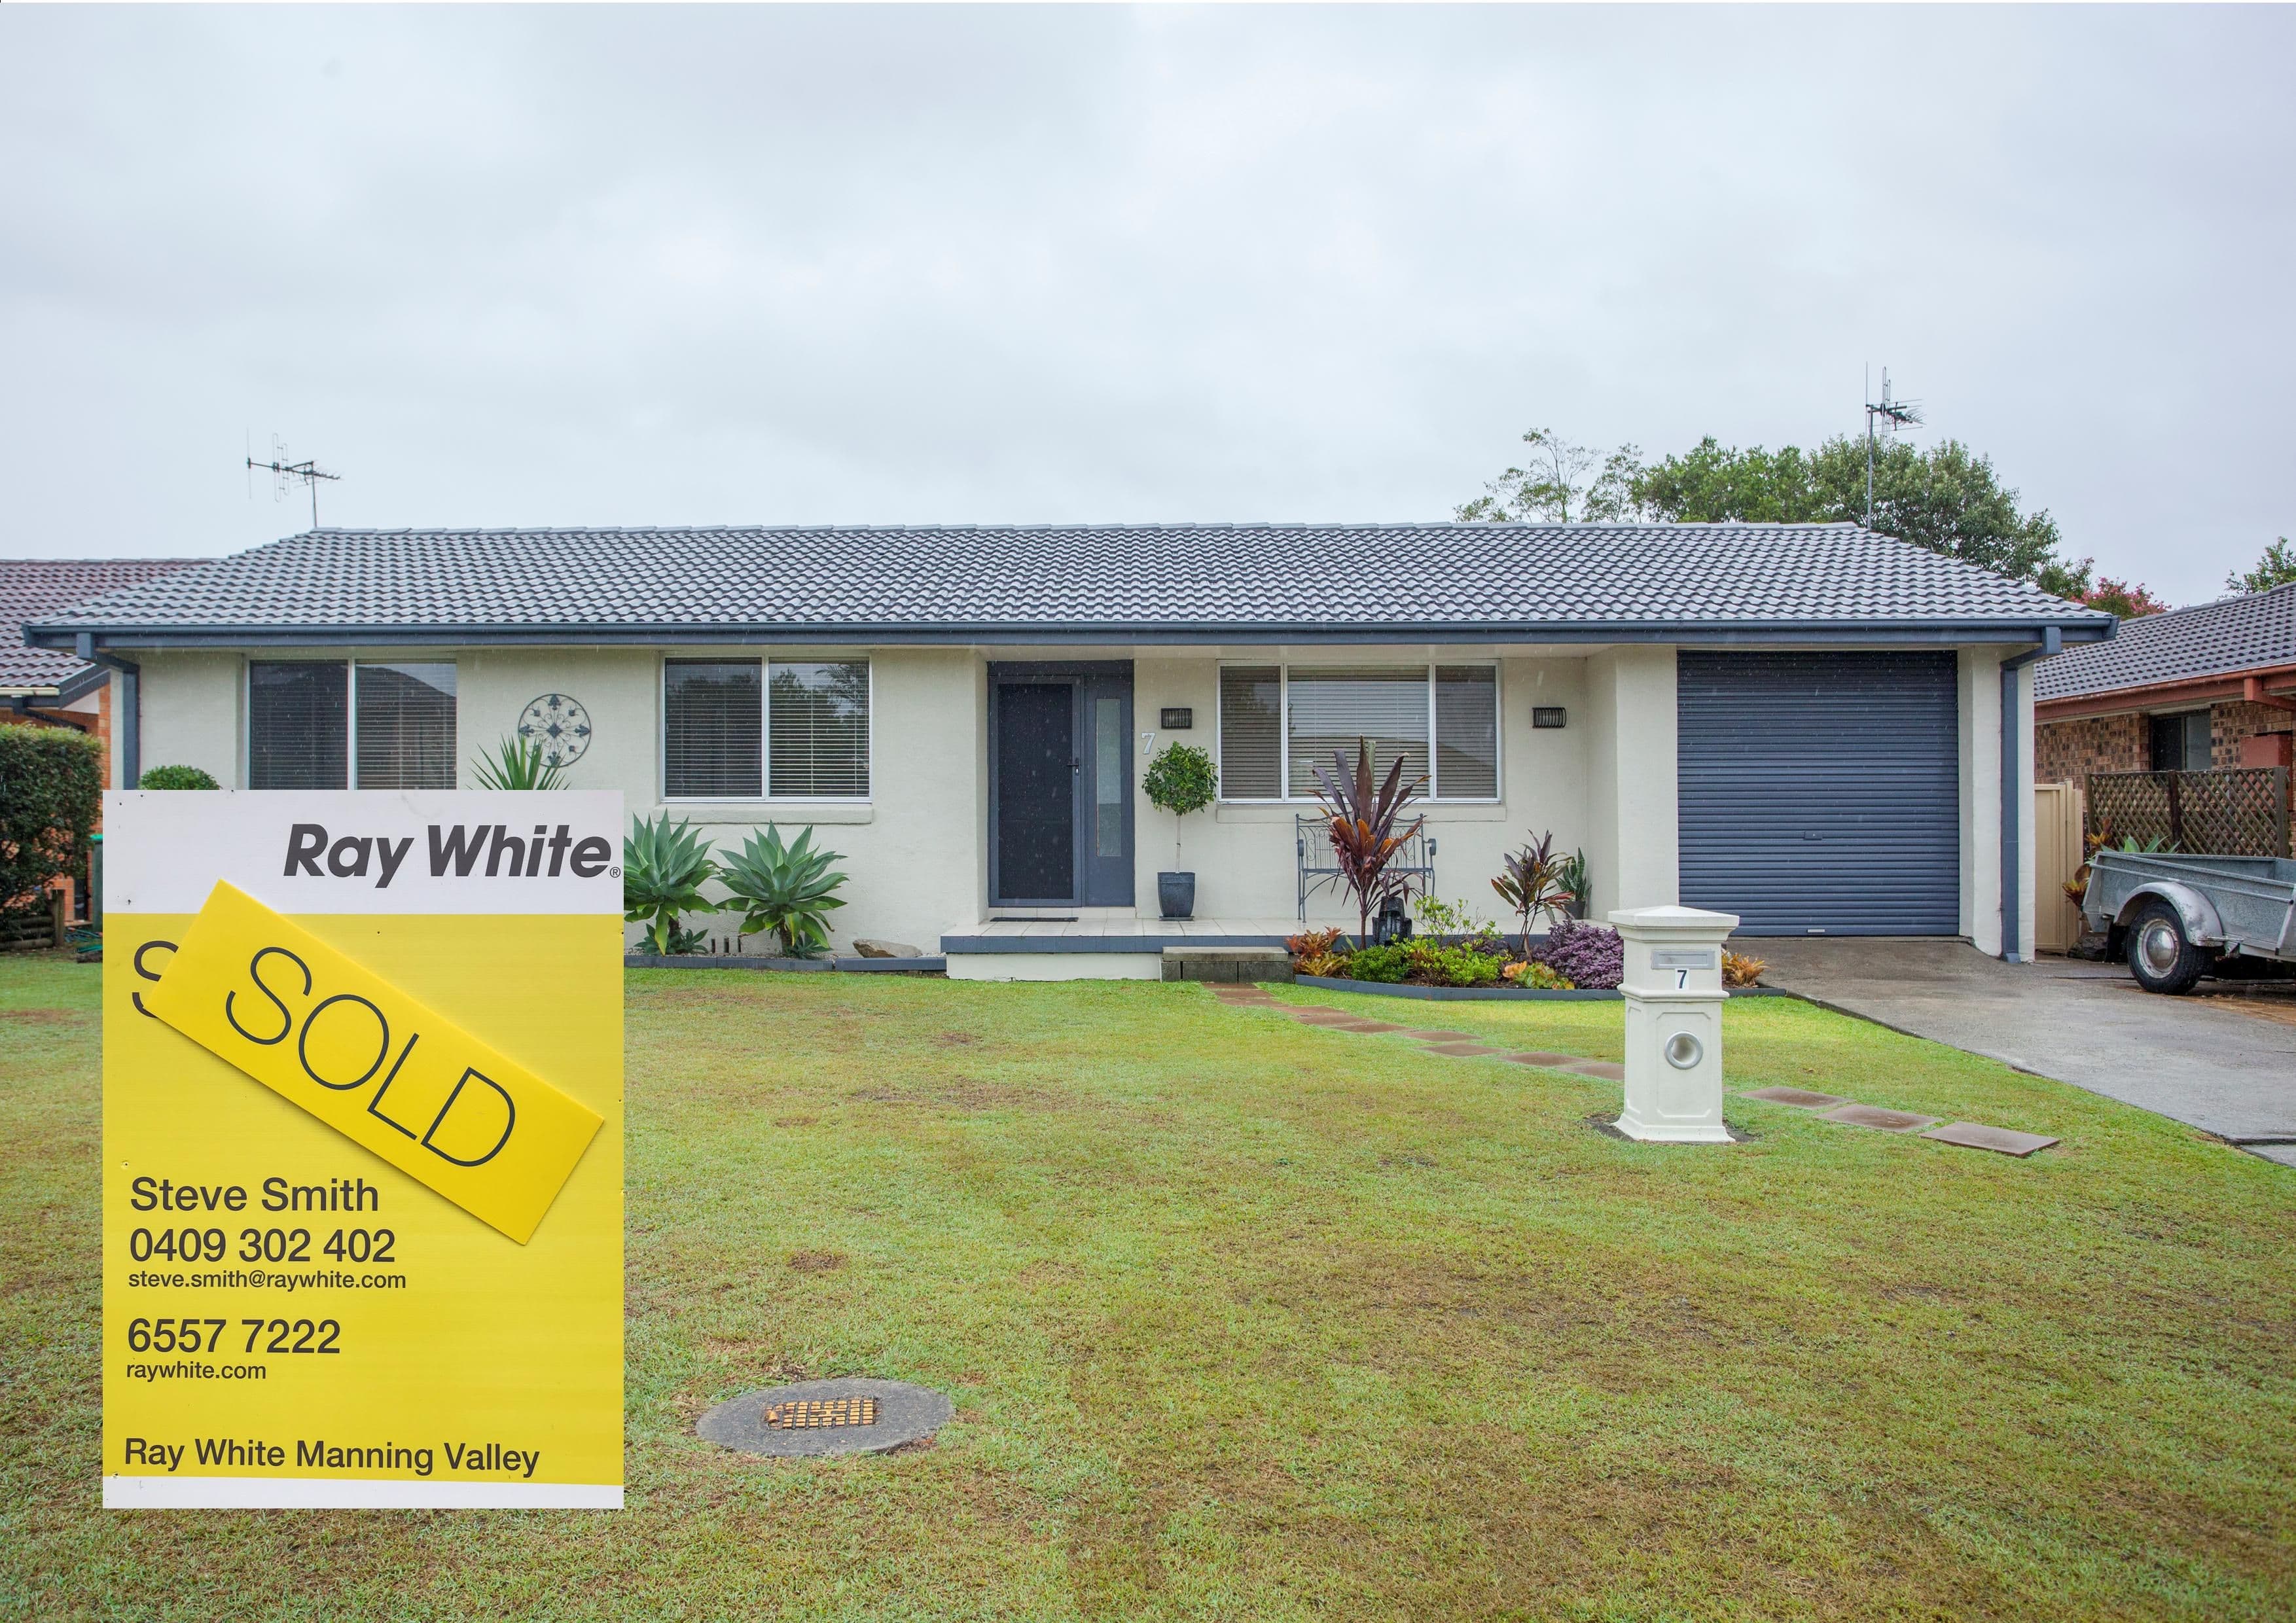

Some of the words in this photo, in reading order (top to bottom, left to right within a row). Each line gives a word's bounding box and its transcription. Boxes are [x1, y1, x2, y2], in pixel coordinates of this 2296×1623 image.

[1141, 732, 1157, 755] 7
[283, 823, 414, 889] Ray
[1677, 969, 1687, 989] 7
[225, 946, 516, 1168] SOLD
[130, 1176, 247, 1211] Steve
[261, 1177, 378, 1211] Smith
[130, 1228, 226, 1262] 0409
[239, 1228, 311, 1262] 302
[323, 1228, 395, 1263] 402
[128, 1270, 406, 1293] steve.smith@raywhite.com
[128, 1318, 226, 1353] 6557
[242, 1319, 340, 1354] 7222
[126, 1361, 266, 1383] raywhite.com
[125, 1438, 185, 1472] Ray
[194, 1438, 285, 1467] White
[296, 1440, 433, 1476] Manning
[443, 1442, 540, 1478] Valley
